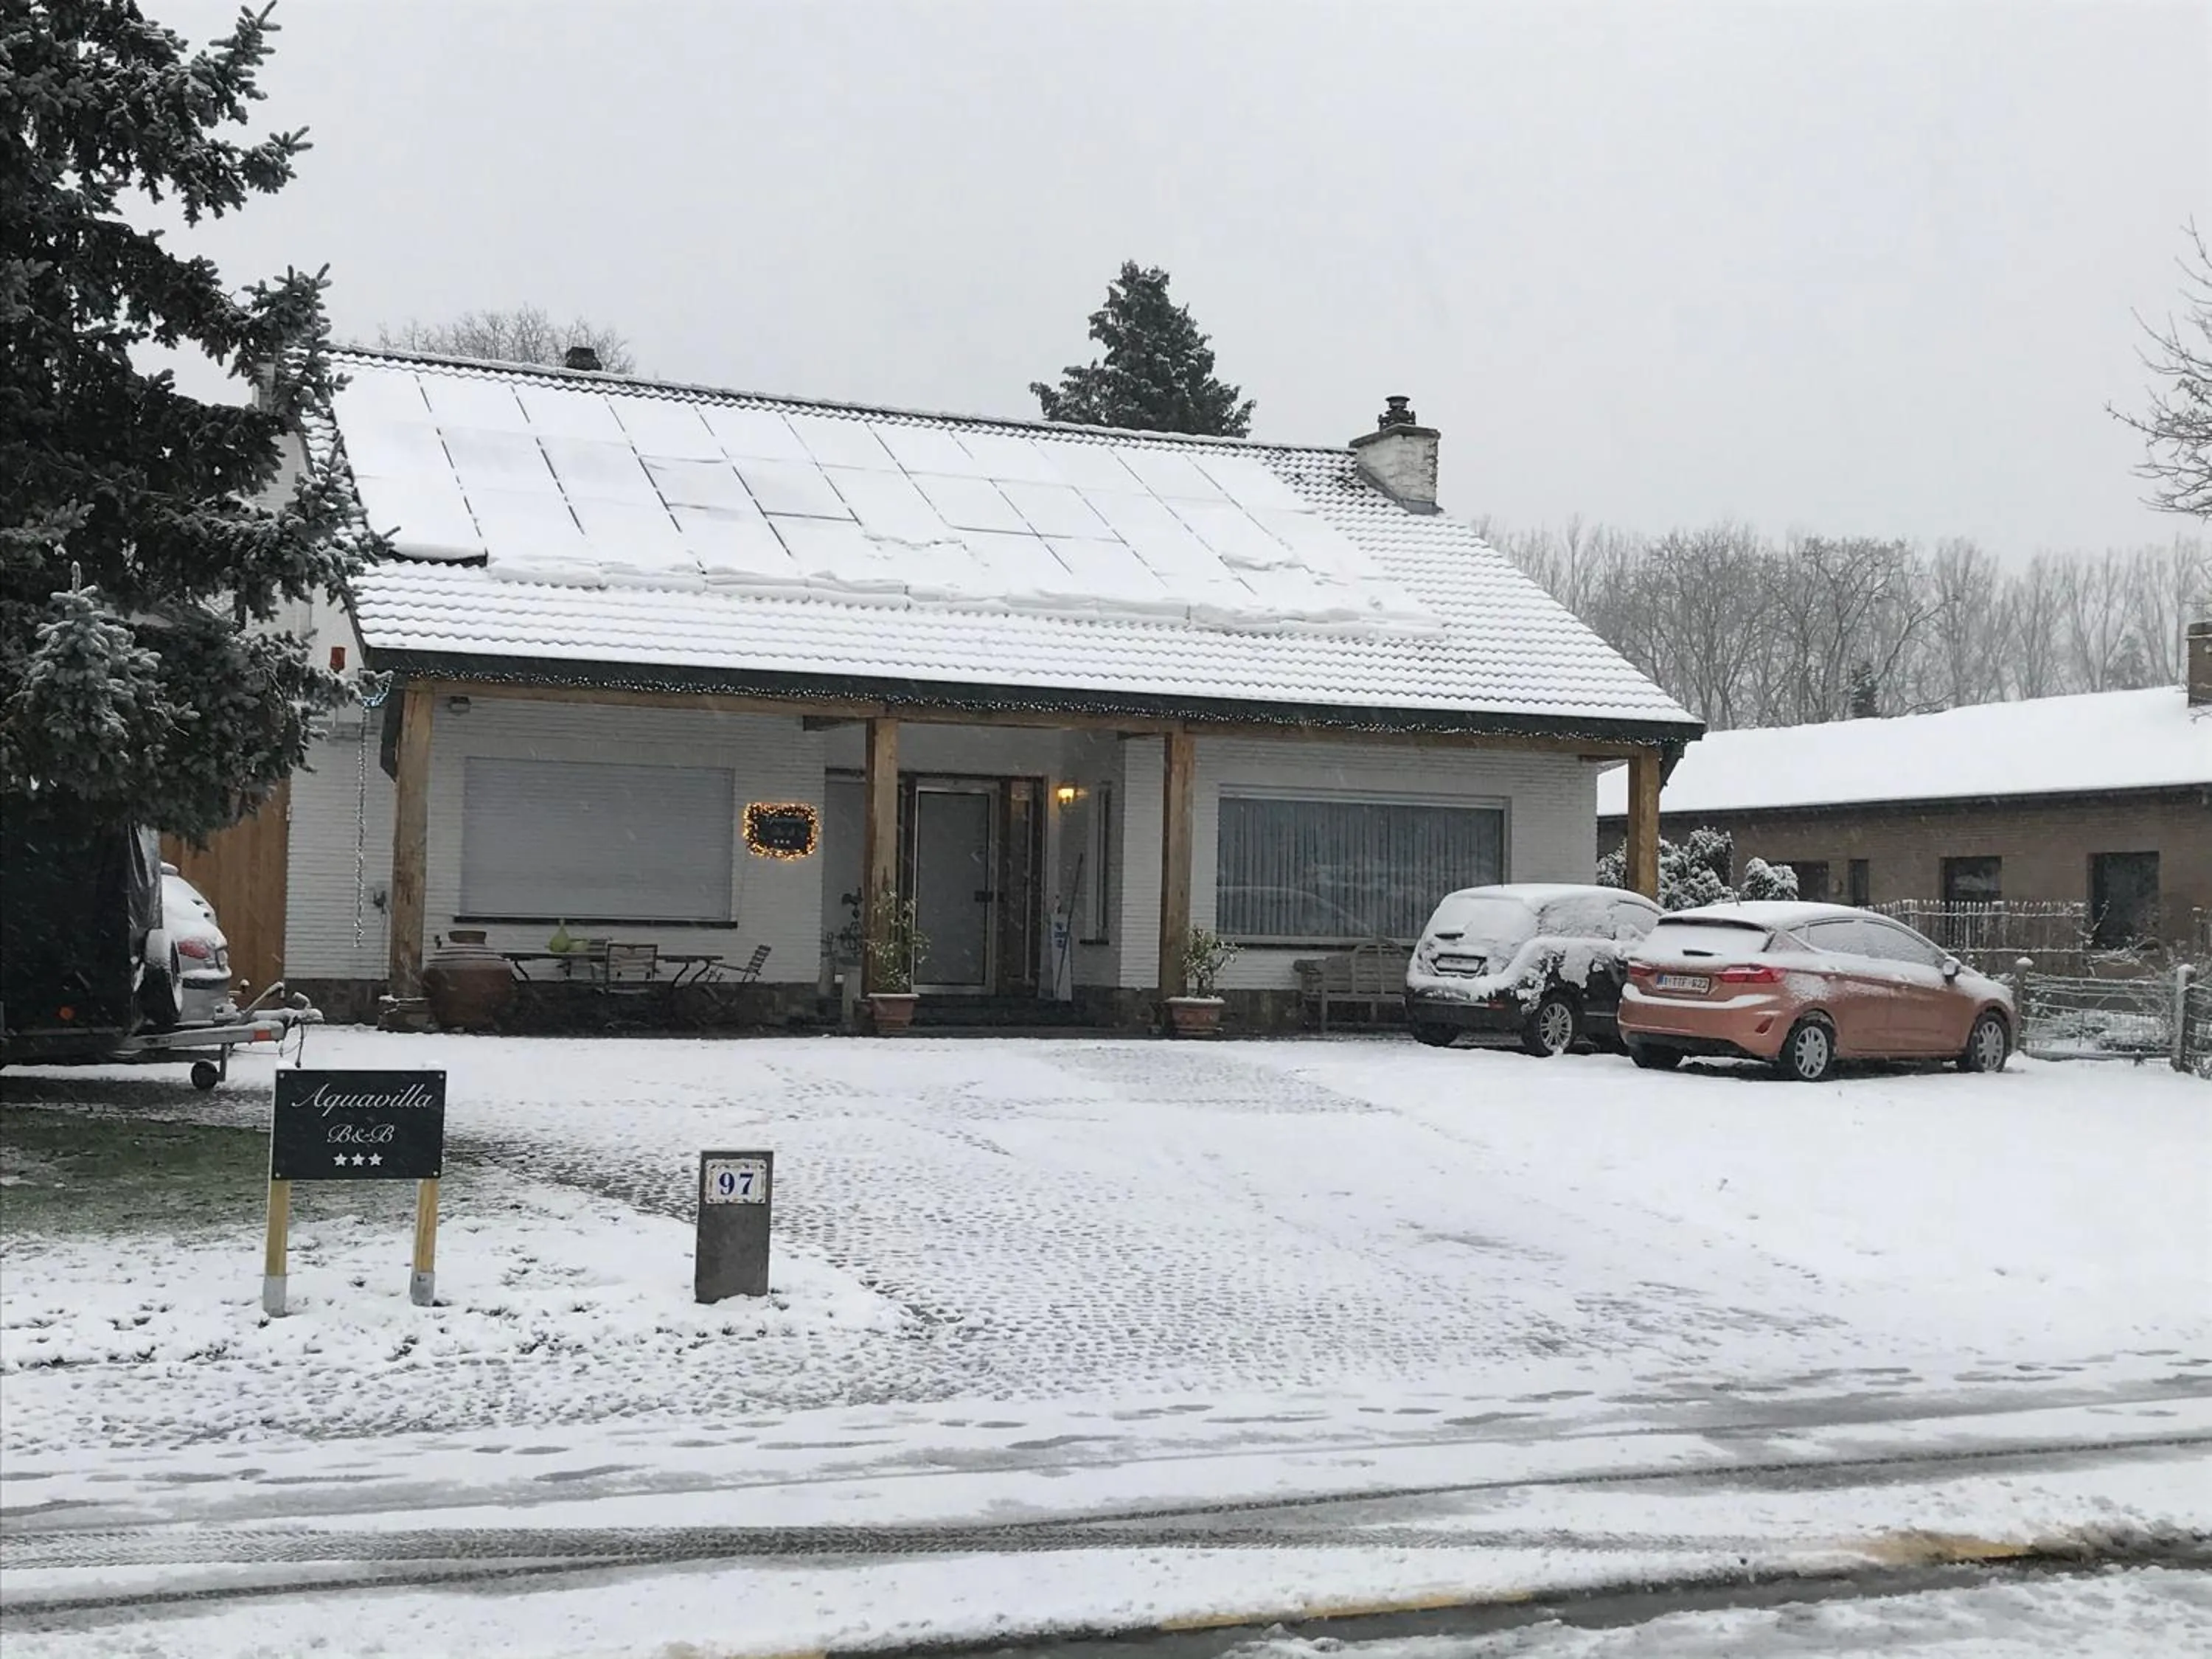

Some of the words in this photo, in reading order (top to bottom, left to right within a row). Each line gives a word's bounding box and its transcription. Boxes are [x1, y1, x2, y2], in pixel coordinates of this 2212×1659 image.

[291, 1083, 433, 1116] Aquavilla
[327, 1123, 394, 1143] B&B
[719, 1172, 754, 1195] 97
